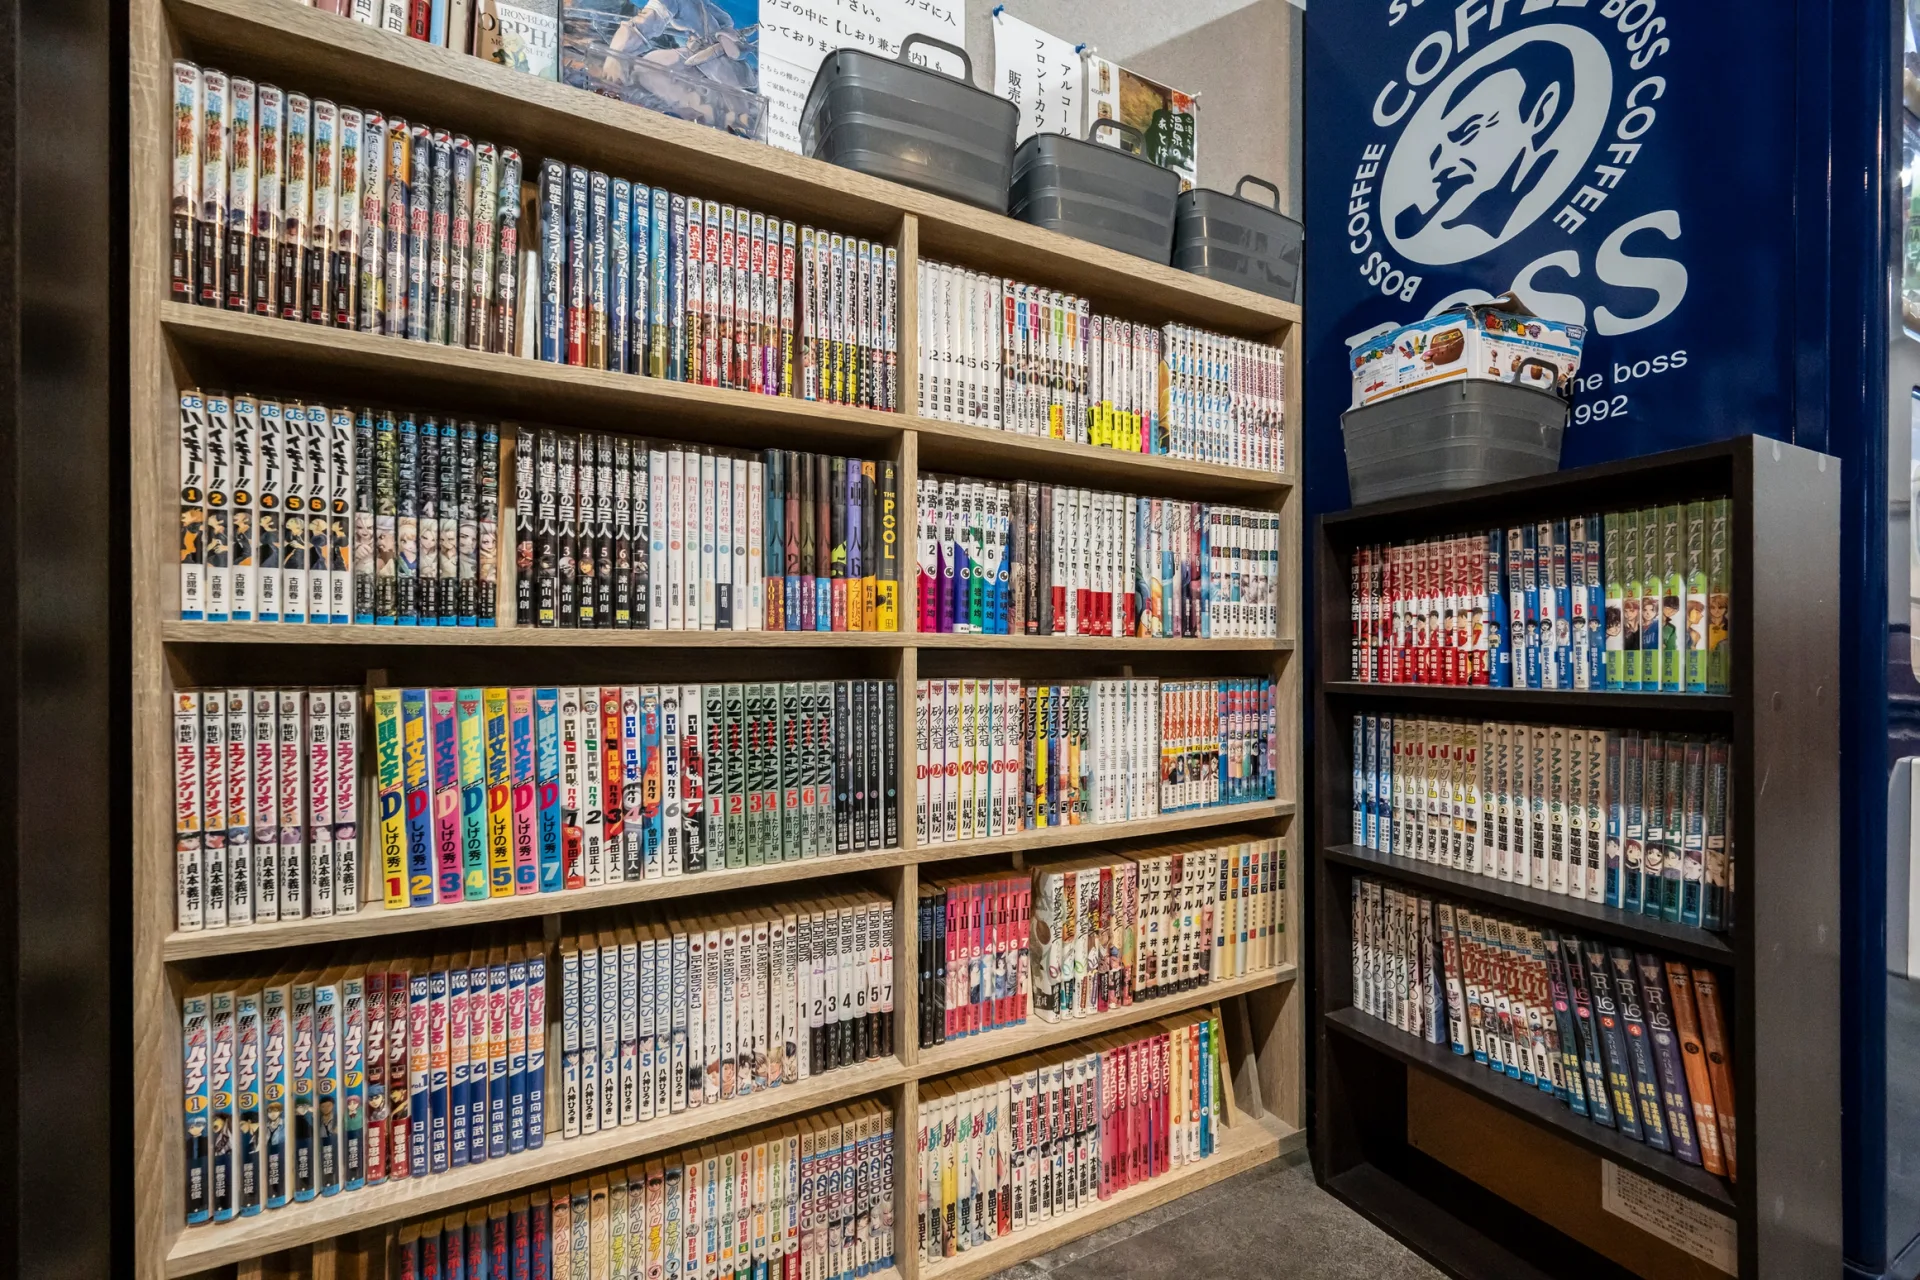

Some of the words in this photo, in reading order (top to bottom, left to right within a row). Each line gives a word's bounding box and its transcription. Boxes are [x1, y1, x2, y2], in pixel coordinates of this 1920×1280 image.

[836, 0, 881, 22] さい。
[1372, 0, 1587, 127] COF
[1034, 38, 1046, 137] フロントカウ
[1553, 76, 1666, 234] COFFEE
[1348, 144, 1386, 254] COFFEE
[1360, 252, 1422, 302] BOSS
[943, 352, 951, 362] 3
[992, 362, 1000, 372] 7
[1614, 349, 1688, 385] boss
[187, 490, 195, 499] 1
[236, 490, 247, 502] 3
[311, 500, 322, 509] 6
[516, 457, 534, 532] 進撃の巨人
[539, 463, 556, 536] 進撃の巨人
[559, 463, 575, 537] 進撃の巨人
[883, 500, 895, 559] POOL
[986, 501, 996, 544] 寄生獣
[521, 541, 530, 551] 1
[543, 544, 551, 555] 2
[563, 547, 571, 557] 3
[976, 547, 982, 556] 7
[988, 550, 994, 559] 6
[1472, 554, 1483, 596] DAYS
[1574, 604, 1582, 615] 6
[931, 706, 944, 749] 砂の栄冠
[378, 718, 399, 786] 頭文字
[489, 718, 508, 781] 頭文字
[513, 716, 530, 780] 頭文字
[177, 745, 196, 819] エヴァンゲリオン
[256, 743, 273, 814] エヴァンゲリオン
[311, 744, 329, 813] エヴァンゲリオン
[381, 792, 402, 820] D
[489, 787, 509, 813] D
[514, 785, 534, 813] D
[730, 797, 742, 812] 2
[566, 811, 578, 827] 1
[588, 811, 601, 824] 2
[1555, 814, 1559, 822] 5
[385, 823, 402, 874] しげの秀一
[493, 815, 507, 864] しげの秀一
[518, 814, 532, 862] しげの秀一
[387, 877, 401, 896] 1
[493, 867, 512, 886] 5
[517, 864, 536, 884] 6
[1140, 878, 1149, 918] リアル
[1184, 871, 1194, 910] リアル
[1141, 925, 1145, 935] 1
[1184, 916, 1191, 927] 5
[829, 996, 836, 1012] 3
[642, 1054, 651, 1066] 5
[568, 1068, 575, 1081] 1
[269, 1086, 279, 1097] 4
[512, 1094, 523, 1140] 日向武史
[1068, 1151, 1074, 1164] 5
[1080, 1147, 1086, 1160] 6
